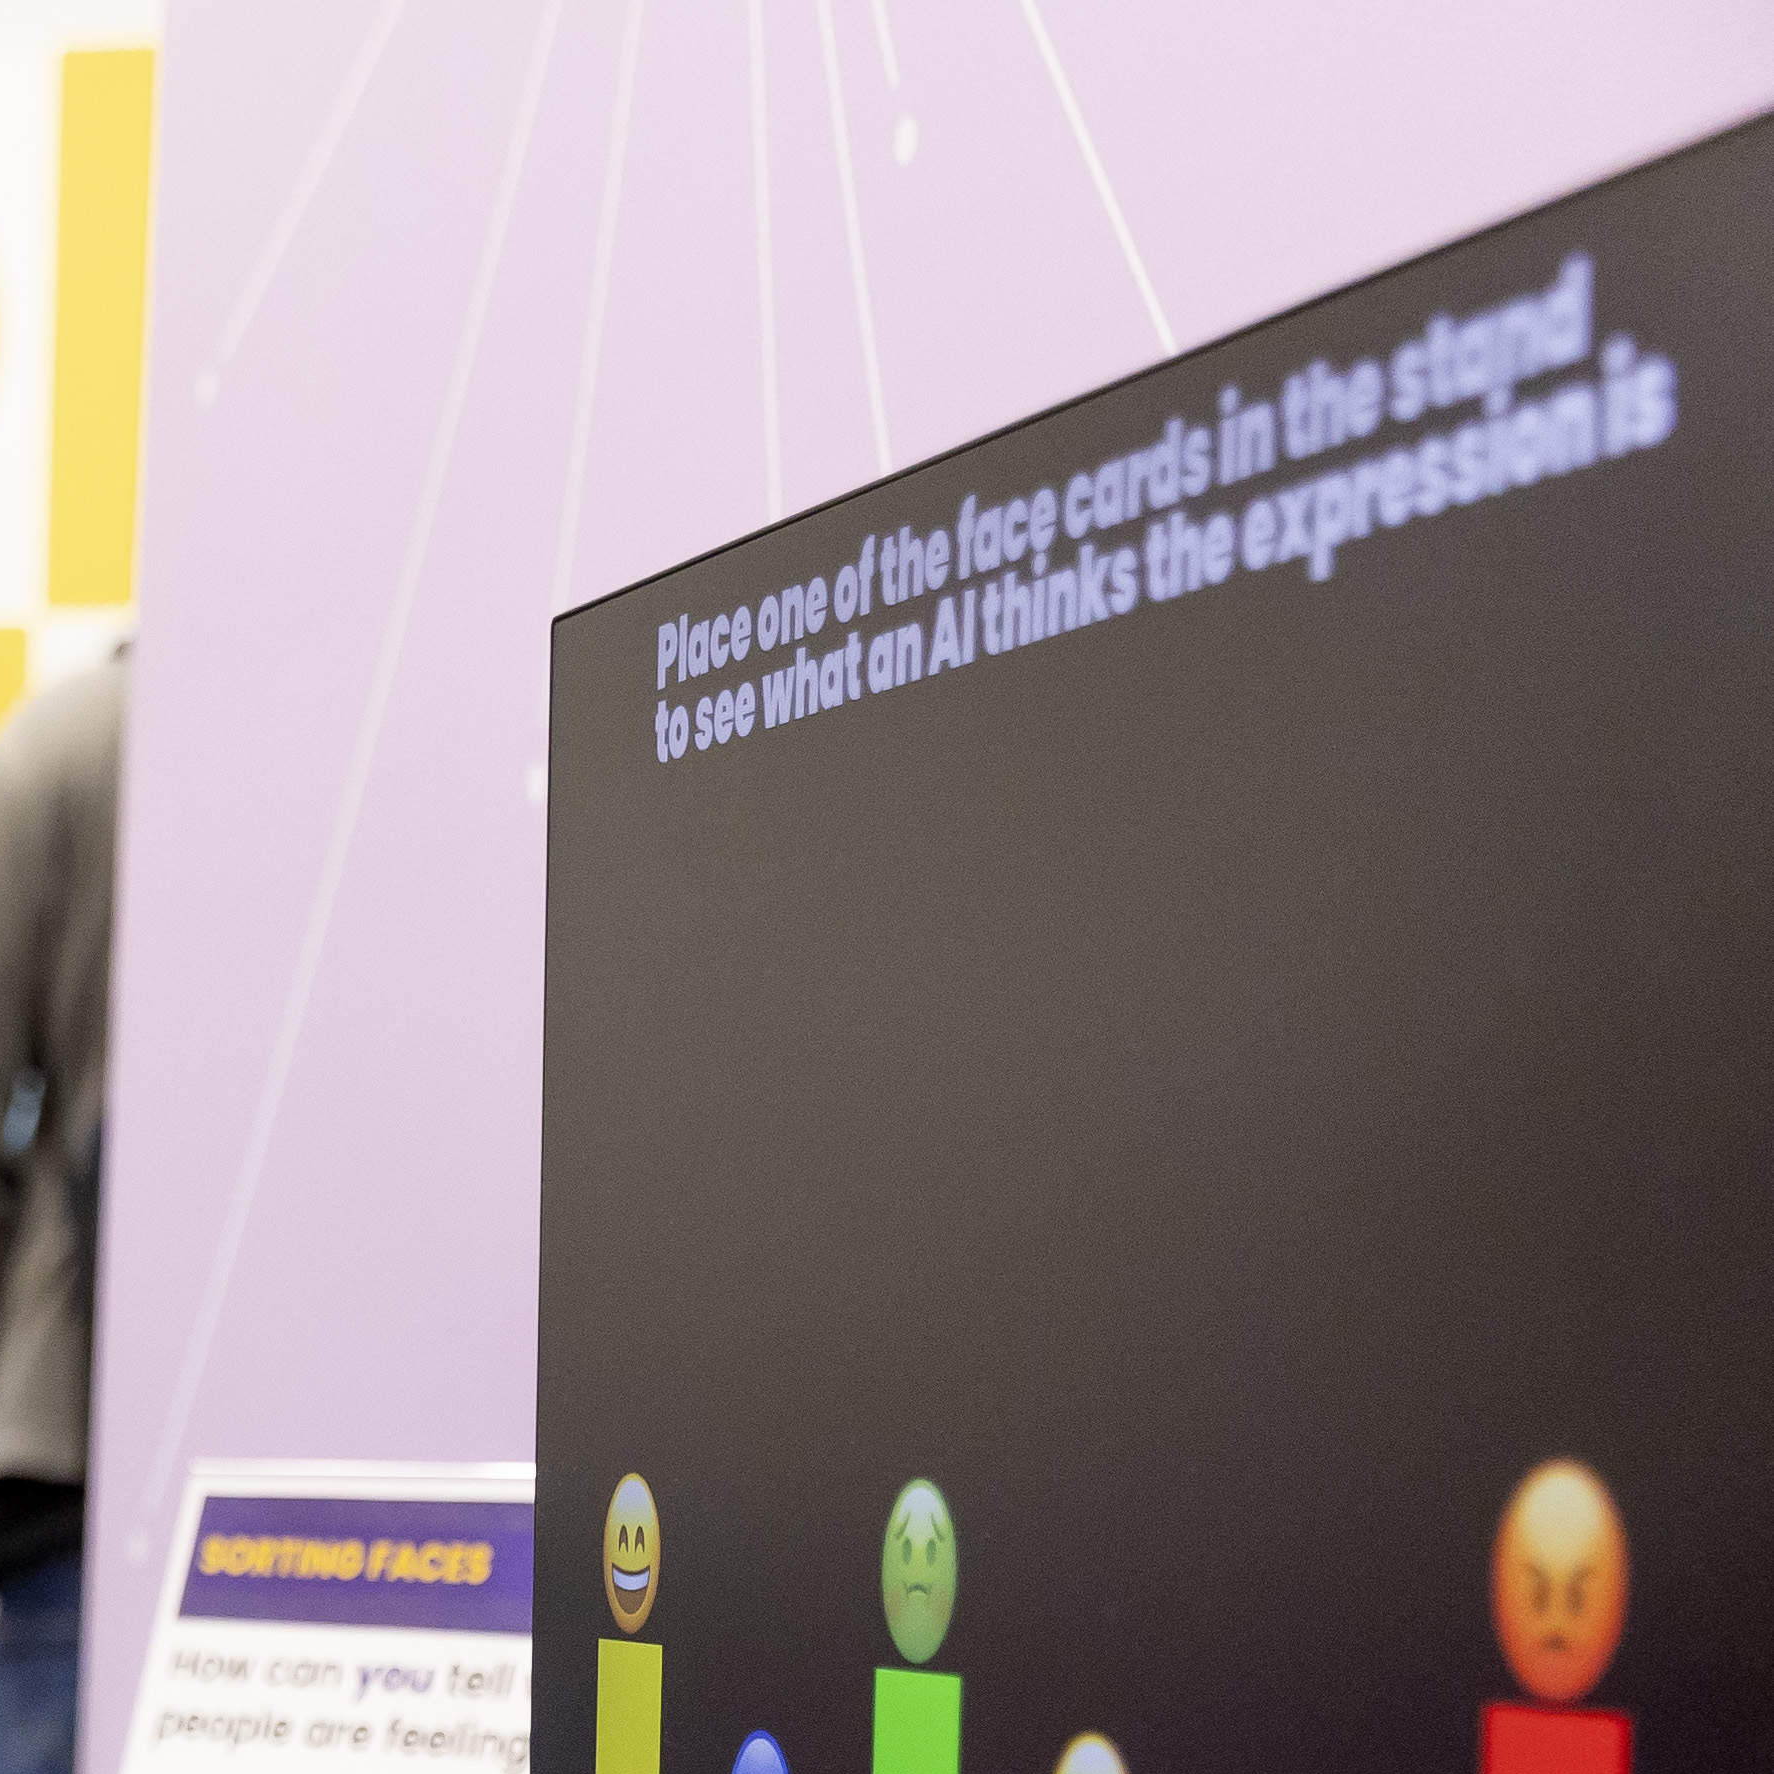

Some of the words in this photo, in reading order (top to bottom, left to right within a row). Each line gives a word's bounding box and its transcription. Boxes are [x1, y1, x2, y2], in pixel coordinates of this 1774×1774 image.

[657, 606, 751, 690] Place
[757, 577, 827, 651] one
[834, 535, 875, 623] of
[881, 525, 949, 606] the
[958, 488, 1056, 580] face
[1065, 418, 1210, 539] cards
[1219, 383, 1276, 485] in
[1282, 358, 1384, 460] the
[1390, 252, 1594, 422] stand
[655, 700, 689, 763] to
[694, 683, 755, 751] see
[761, 647, 862, 729] what
[867, 623, 923, 694] an
[928, 589, 976, 676] AI
[981, 543, 1138, 655] thinks
[1145, 510, 1235, 601] the
[1242, 383, 1598, 582] expression
[1602, 332, 1679, 458] is
[199, 1532, 366, 1581] SORTING
[367, 1539, 494, 1585] FACES
[173, 1649, 250, 1682] How
[265, 1658, 342, 1690] can
[357, 1664, 434, 1700] you
[448, 1657, 515, 1699] tell
[157, 1710, 288, 1751] people
[305, 1721, 372, 1750] are
